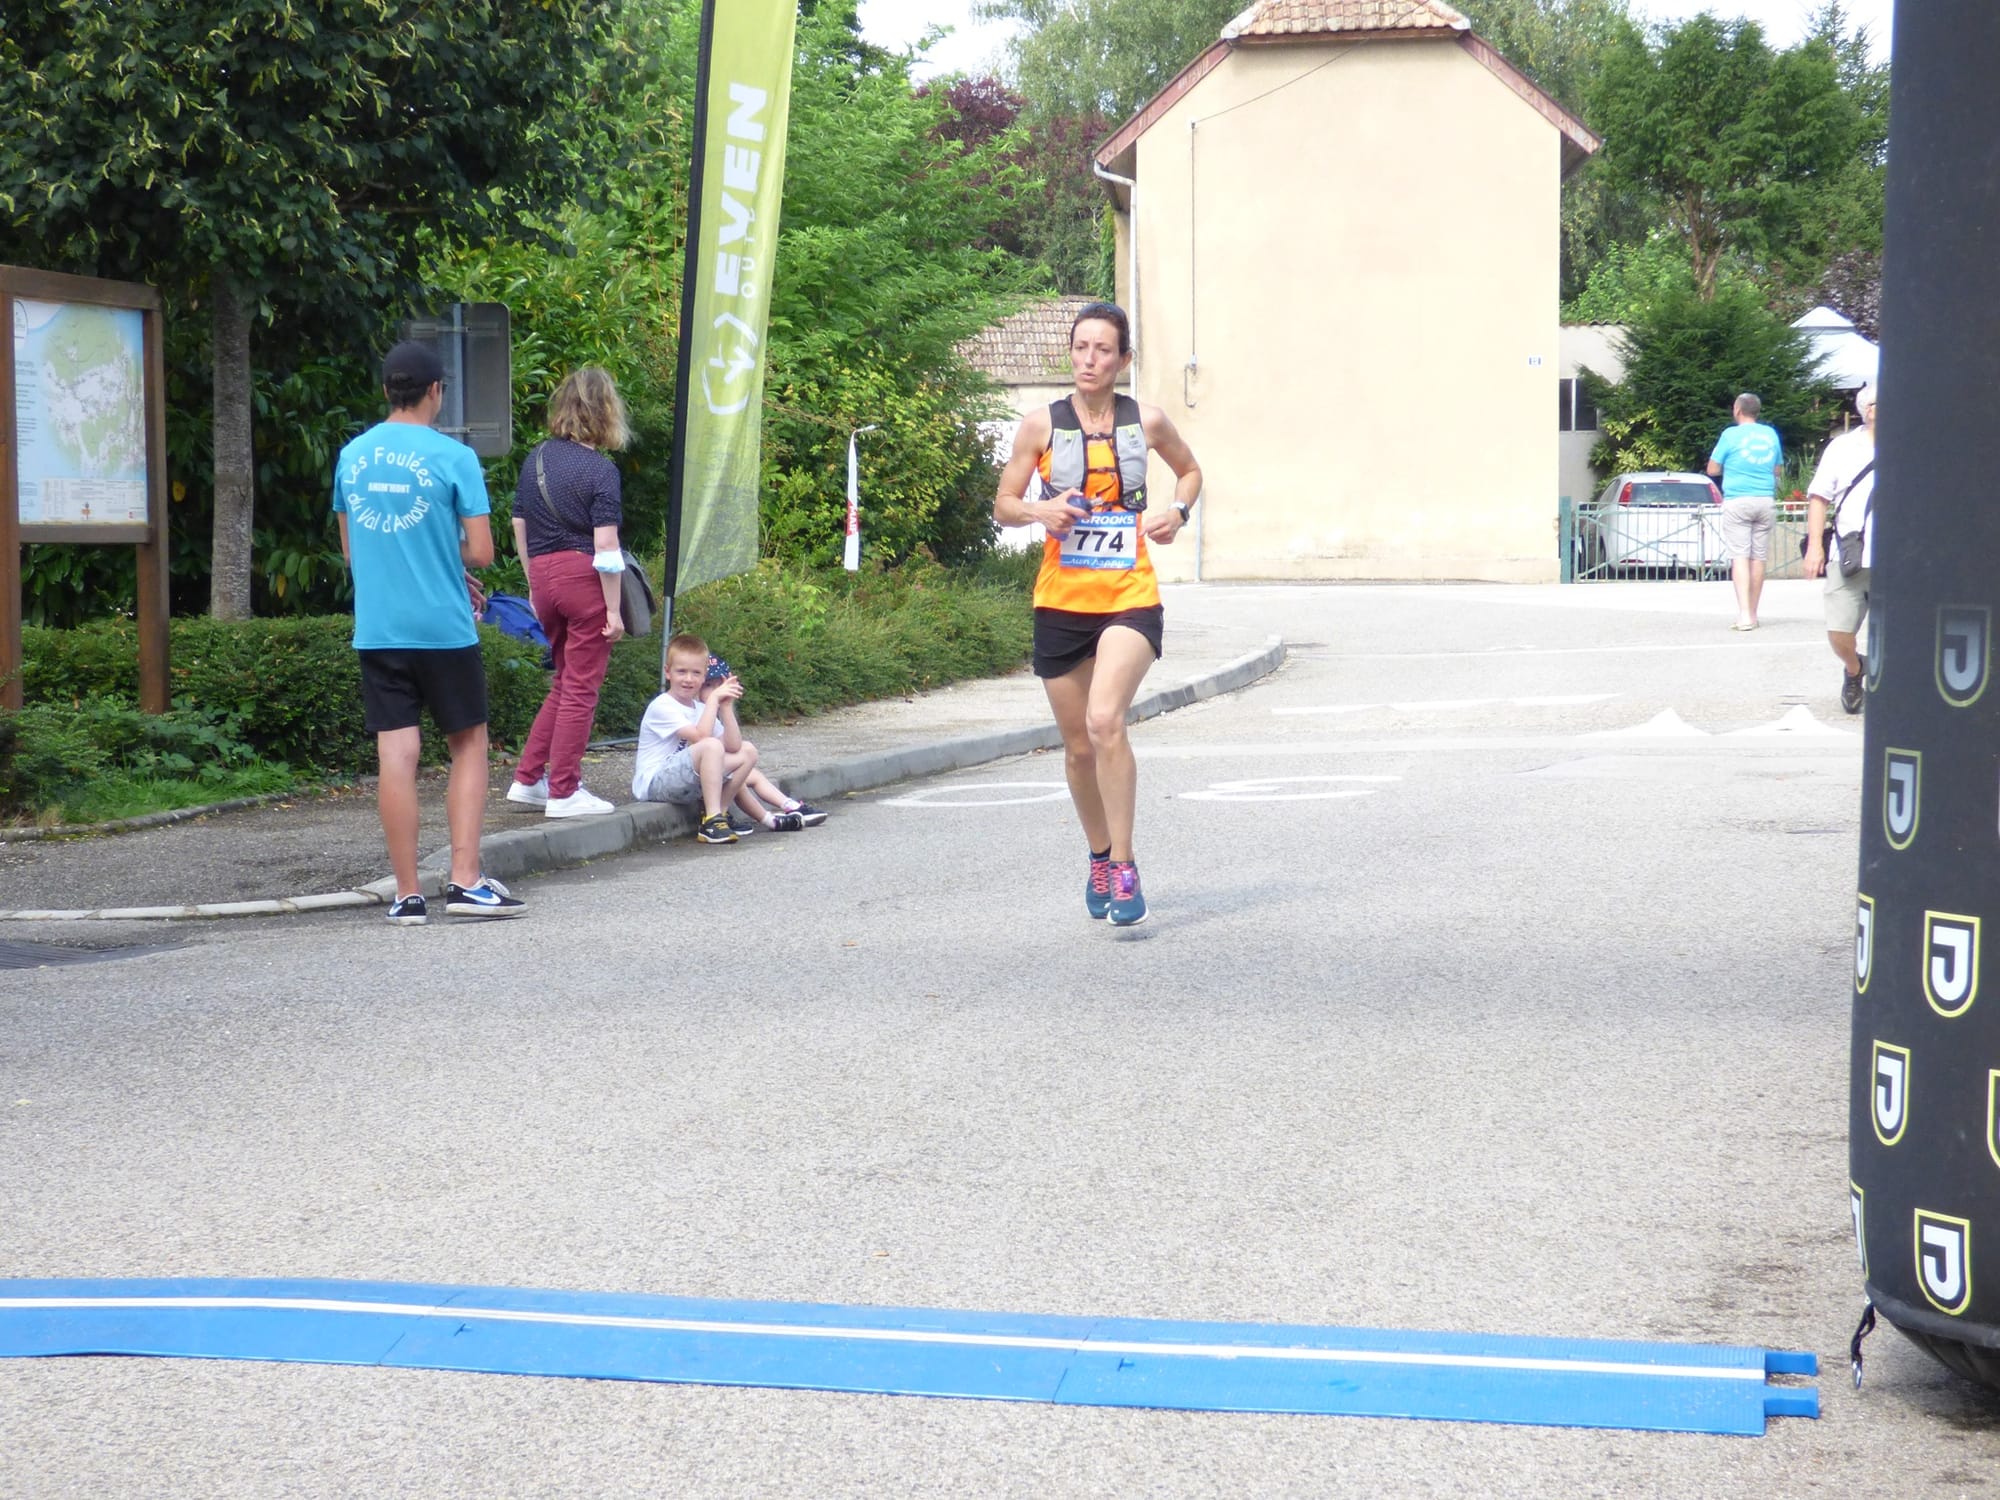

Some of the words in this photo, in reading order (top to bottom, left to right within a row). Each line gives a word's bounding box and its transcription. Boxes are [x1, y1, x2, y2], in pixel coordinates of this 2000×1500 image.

[344, 455, 368, 485] Les
[374, 446, 433, 487] Foulées
[347, 494, 367, 513] du
[356, 509, 382, 530] Val
[382, 496, 431, 533] d'Amour
[1074, 529, 1124, 553] 774
[1944, 617, 1981, 691] J
[1889, 762, 1914, 834] J
[1932, 926, 1970, 1001] J
[1877, 1055, 1904, 1130] J
[1923, 1224, 1961, 1301] J
